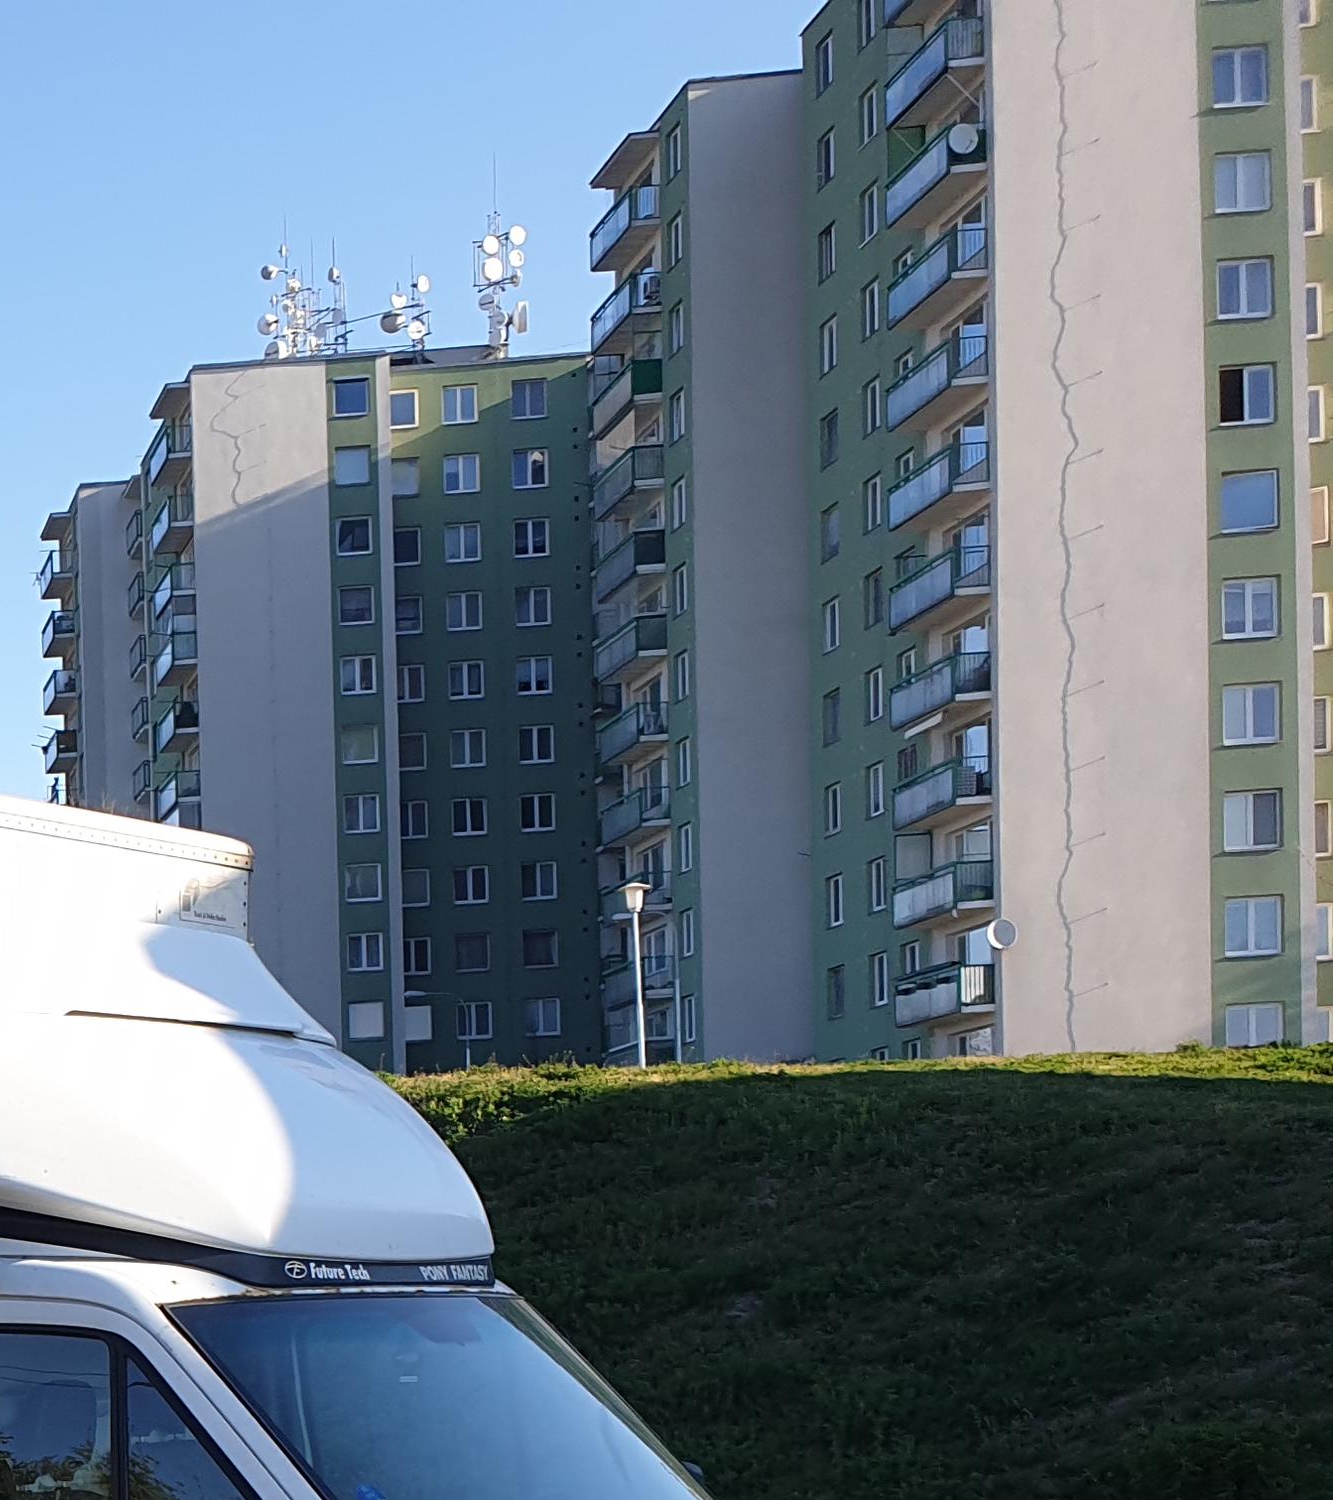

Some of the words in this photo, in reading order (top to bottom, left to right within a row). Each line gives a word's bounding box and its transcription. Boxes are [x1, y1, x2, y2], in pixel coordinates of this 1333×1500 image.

[309, 1262, 345, 1280] Future
[345, 1264, 371, 1280] Tech
[419, 1265, 449, 1281] PONY
[450, 1264, 489, 1281] FANTASY
